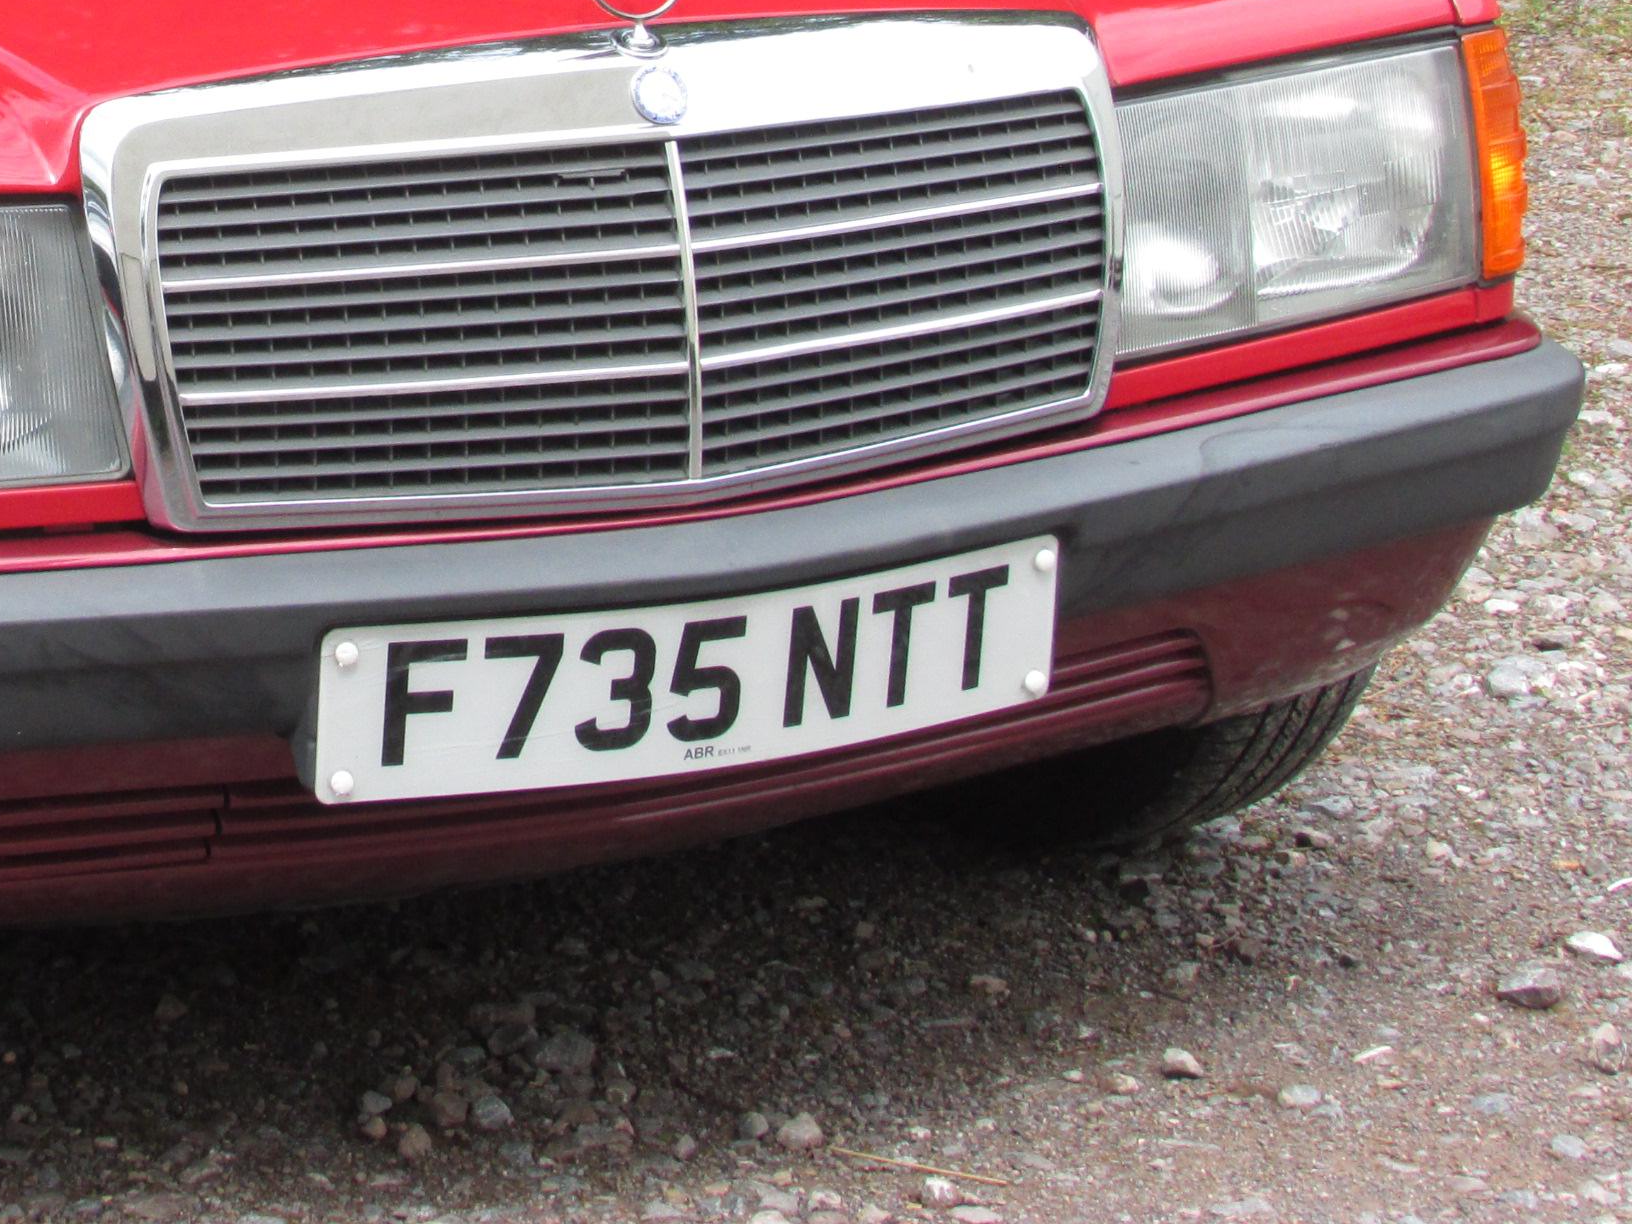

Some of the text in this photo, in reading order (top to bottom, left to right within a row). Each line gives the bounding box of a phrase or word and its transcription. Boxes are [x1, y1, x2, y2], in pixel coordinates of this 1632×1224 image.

[381, 565, 1009, 766] F735 NTT
[684, 745, 714, 760] ABR
